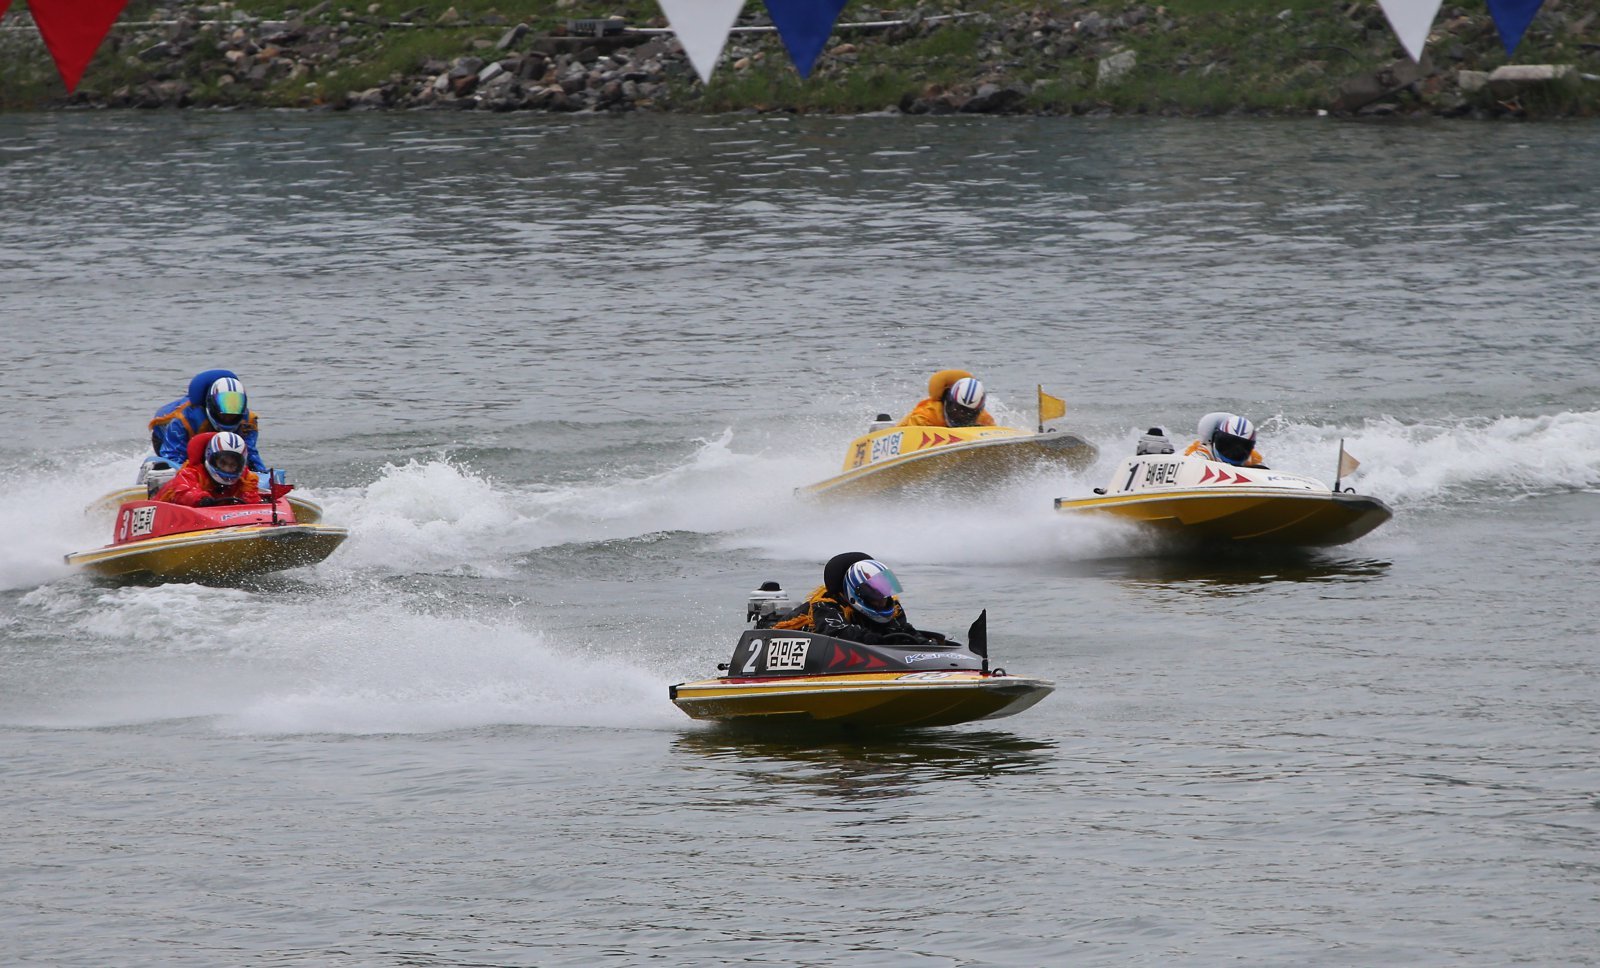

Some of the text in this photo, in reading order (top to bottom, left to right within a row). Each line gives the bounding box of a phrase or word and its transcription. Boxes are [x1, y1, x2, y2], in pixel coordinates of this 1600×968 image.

[872, 433, 901, 461] 손지영
[1124, 463, 1140, 491] 1
[119, 510, 130, 540] 3
[742, 638, 763, 673] 2
[770, 640, 806, 668] 김민준
